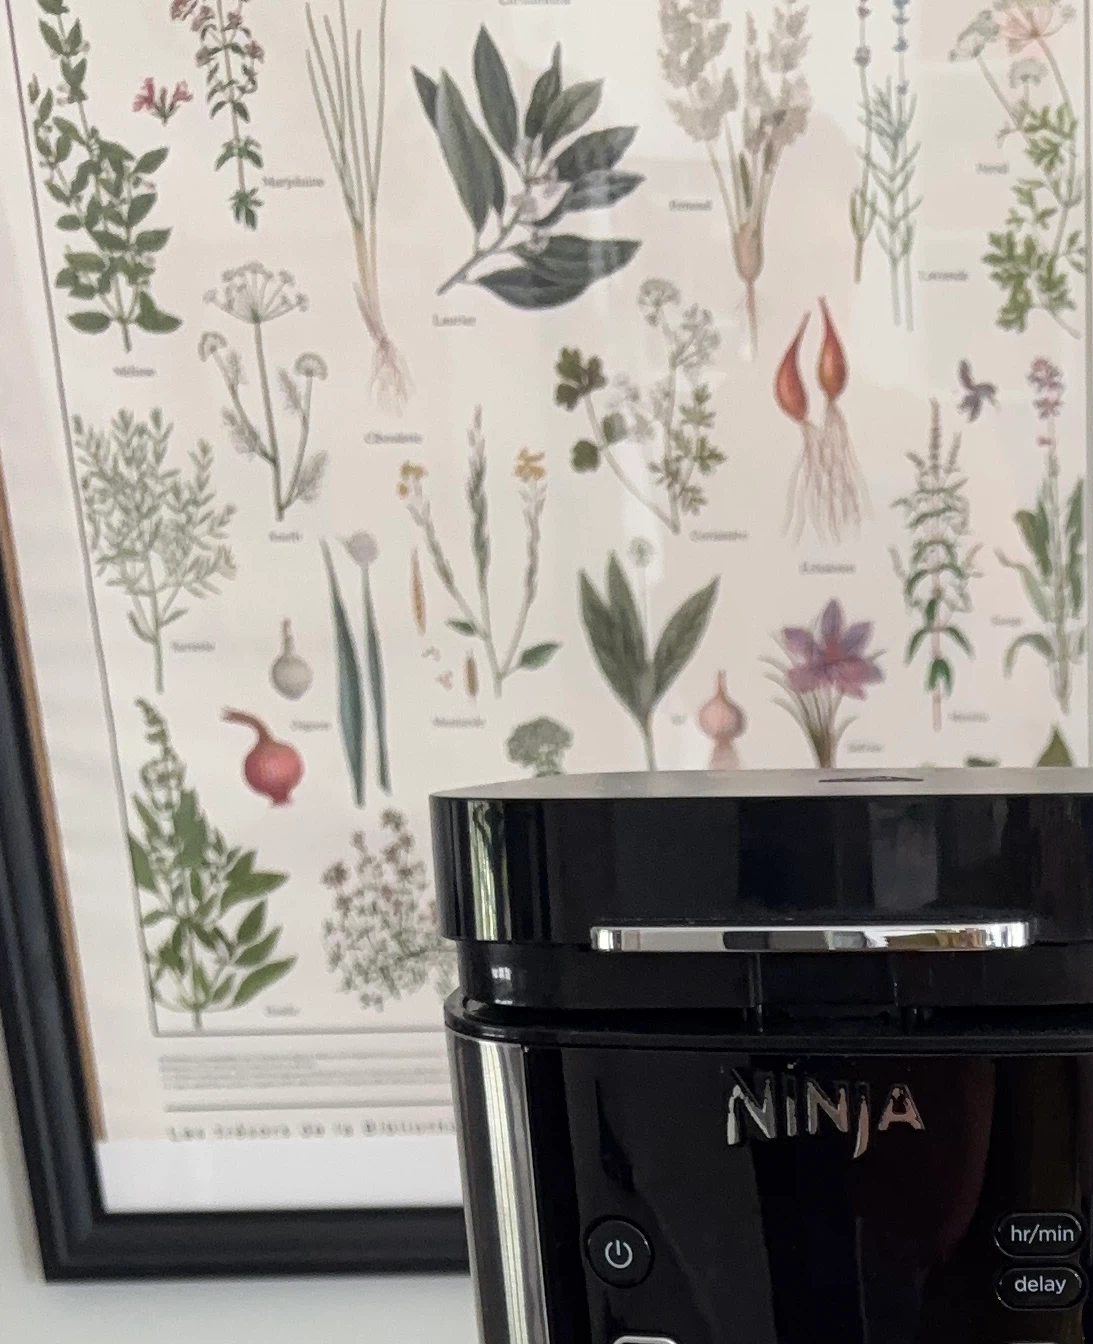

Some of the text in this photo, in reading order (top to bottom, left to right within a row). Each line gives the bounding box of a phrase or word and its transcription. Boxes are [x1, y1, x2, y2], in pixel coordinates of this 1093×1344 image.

[726, 1066, 925, 1160] NINJA
[1010, 1224, 1074, 1244] hr/min
[1014, 1275, 1066, 1295] delay
